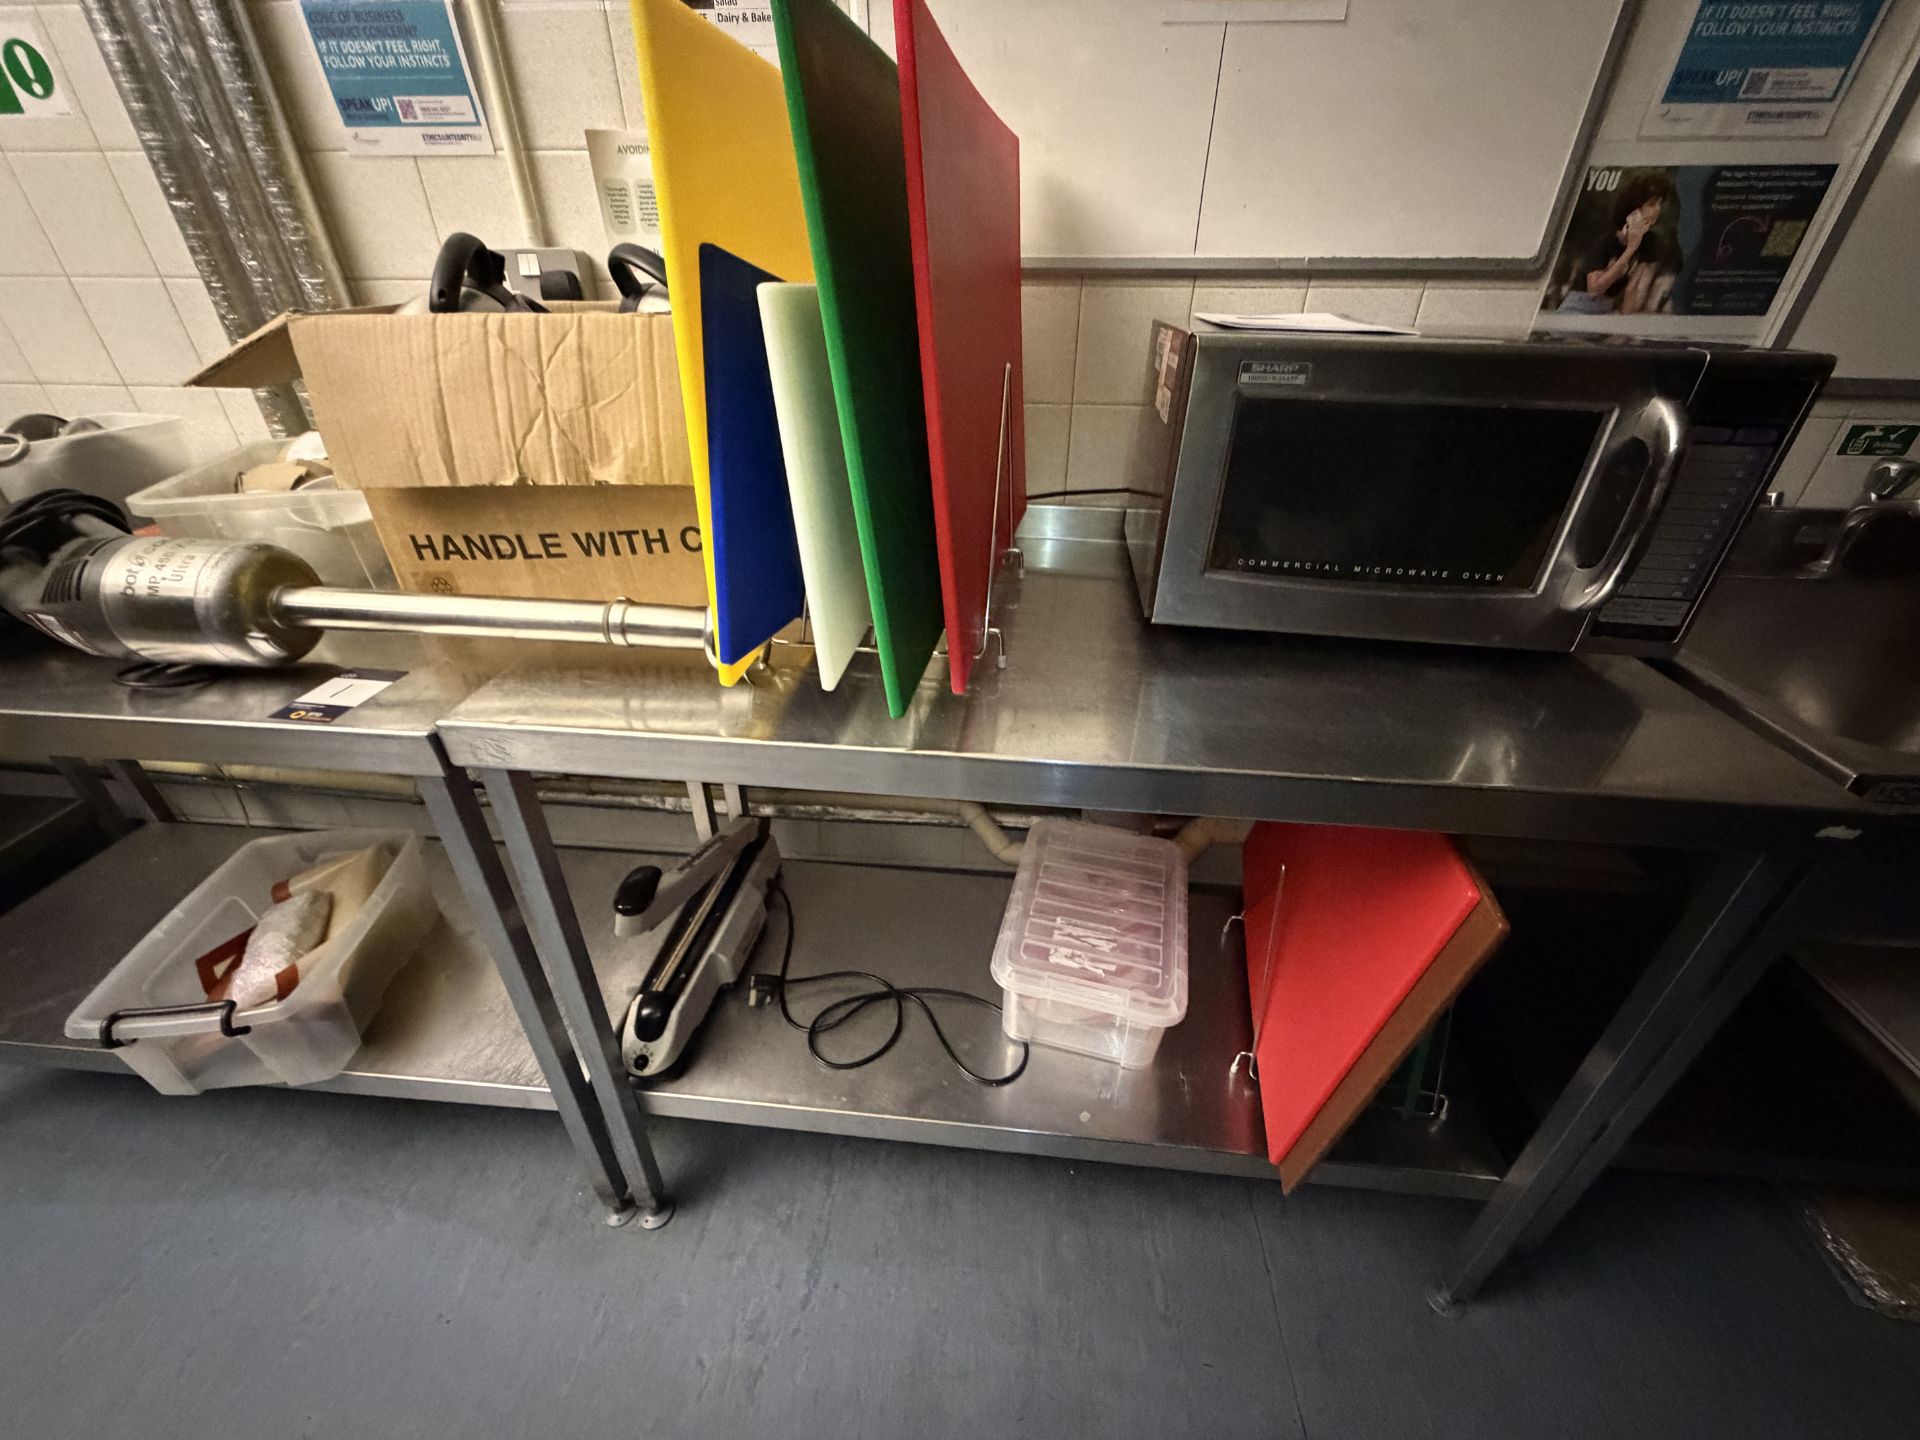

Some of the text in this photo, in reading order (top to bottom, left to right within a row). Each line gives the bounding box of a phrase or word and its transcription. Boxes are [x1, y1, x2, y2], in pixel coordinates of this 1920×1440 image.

[717, 12, 740, 24] Dairy
[741, 13, 749, 22] &
[1788, 4, 1820, 18] FEEL
[1695, 21, 1750, 36] FOLLOW
[1752, 21, 1788, 36] YOUR
[318, 38, 446, 54] IF IT DOESN'T FEEL RIGHT,
[323, 54, 451, 69] FOLLOW YOUR INSTINCTS
[1587, 169, 1622, 192] YOU
[1251, 363, 1299, 373] SHARP
[410, 533, 568, 561] HANDLE
[571, 528, 670, 558] WITH
[168, 554, 196, 582] Ultra
[1237, 558, 1505, 582] COMMERCIAL MICROWAVE OVEN
